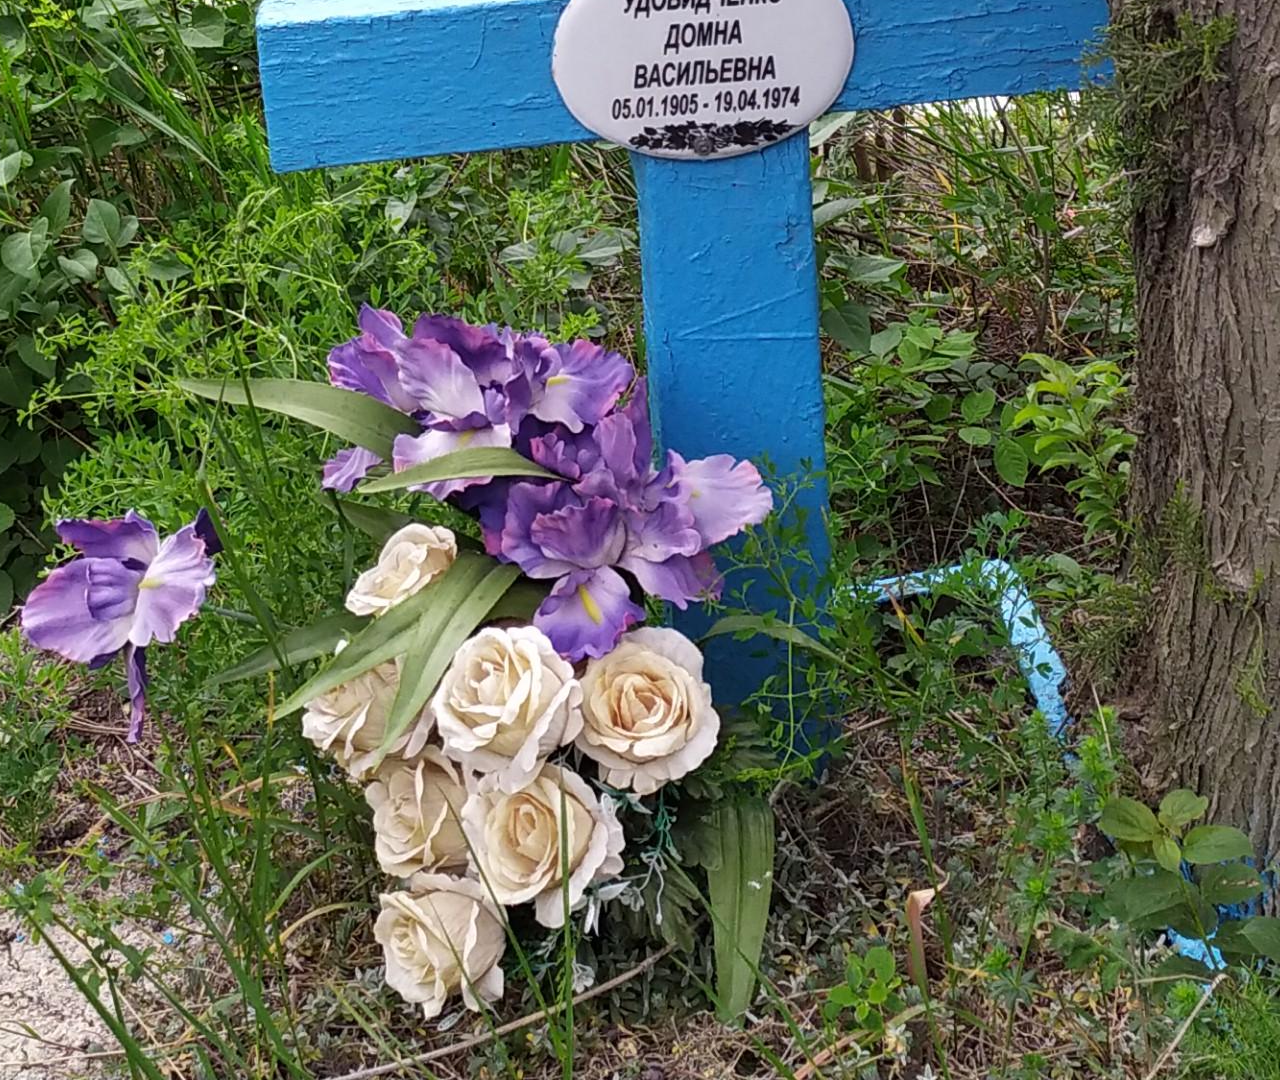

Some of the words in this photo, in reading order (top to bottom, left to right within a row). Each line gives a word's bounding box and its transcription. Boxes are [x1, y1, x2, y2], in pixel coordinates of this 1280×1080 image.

[663, 19, 742, 56] ДОМНА
[634, 55, 776, 89] ВАСИЛЬЕВНА
[612, 93, 699, 120] 05.01.1905
[714, 85, 801, 113] 19.04.1974
